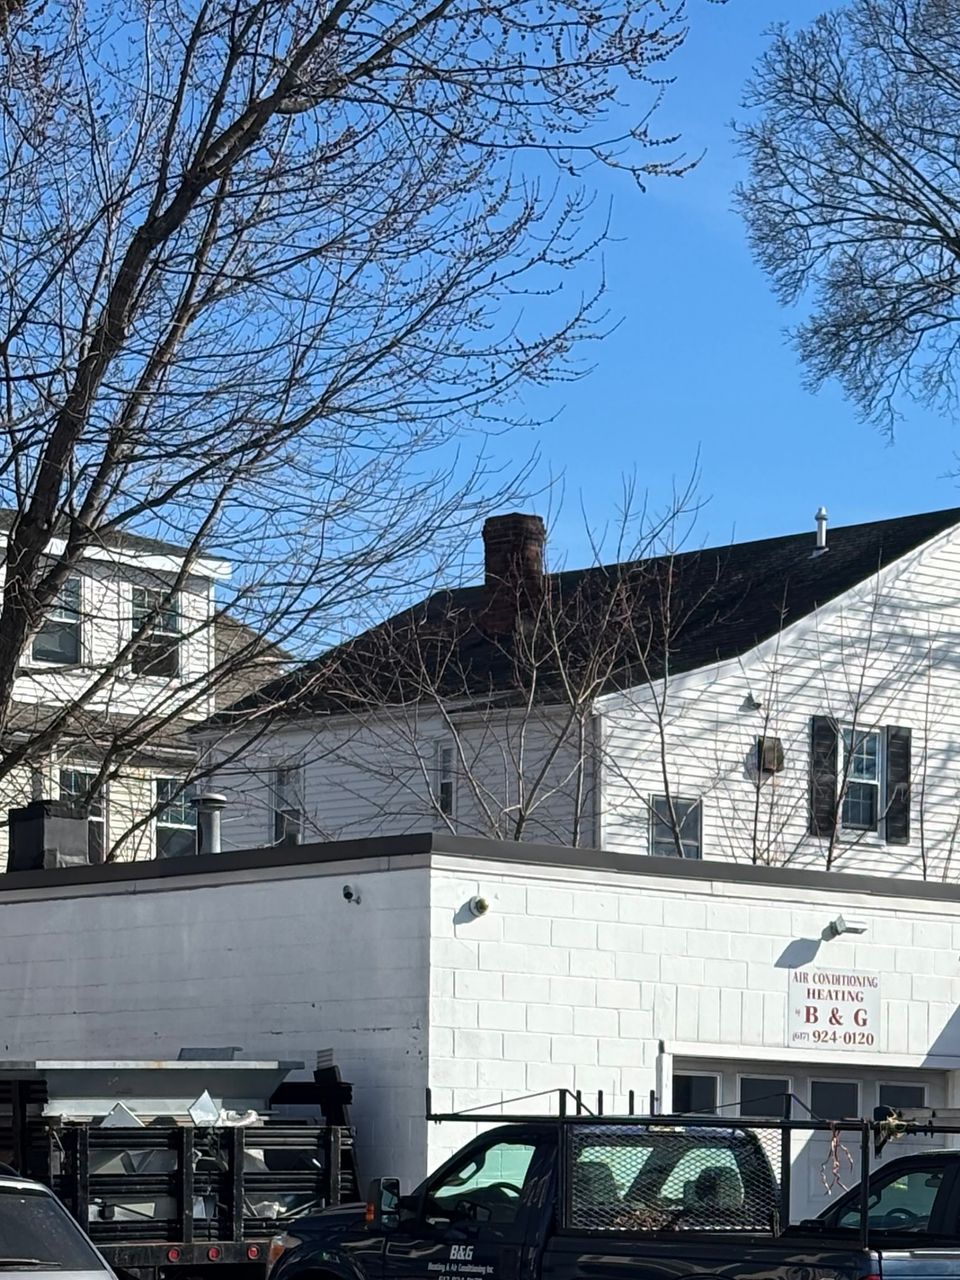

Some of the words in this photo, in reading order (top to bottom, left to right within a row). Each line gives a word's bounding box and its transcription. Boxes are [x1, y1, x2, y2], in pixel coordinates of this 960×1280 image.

[793, 971, 809, 984] AIR
[812, 973, 878, 988] CONDITIONING
[807, 988, 864, 1003] HEATING
[804, 1005, 819, 1024] B
[828, 1007, 844, 1026] &
[854, 1008, 868, 1027] G
[812, 1030, 874, 1046] 924-0120
[450, 1245, 474, 1260] B&G
